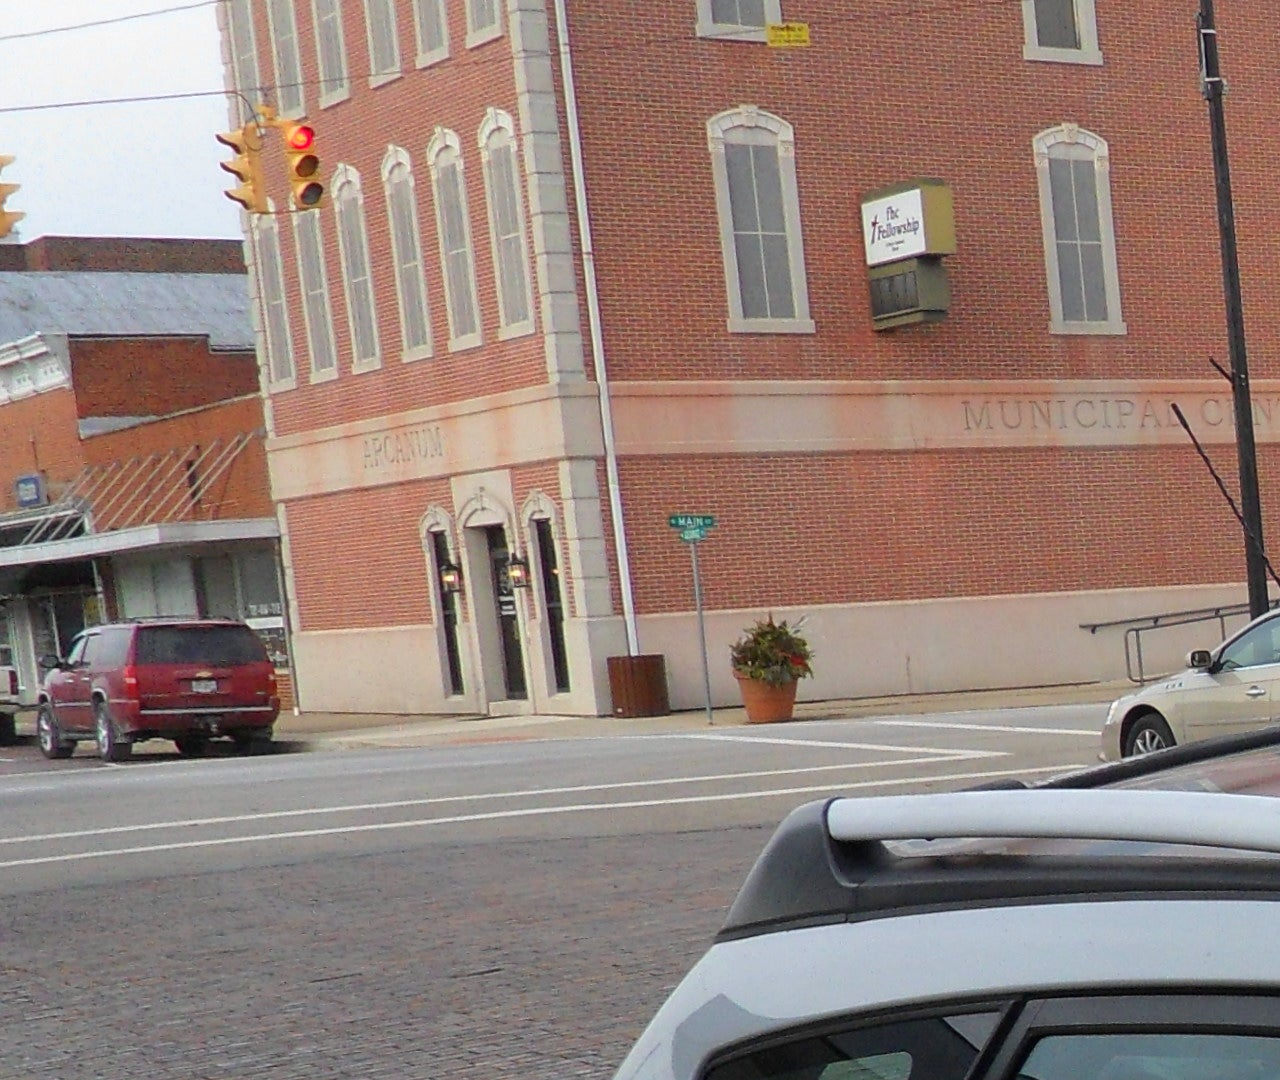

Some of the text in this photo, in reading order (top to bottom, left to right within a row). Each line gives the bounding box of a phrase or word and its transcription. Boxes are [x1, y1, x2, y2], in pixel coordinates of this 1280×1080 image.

[878, 217, 920, 240] Fellowship
[961, 399, 1183, 431] MUNICIPAL
[678, 516, 704, 526] MAIN
